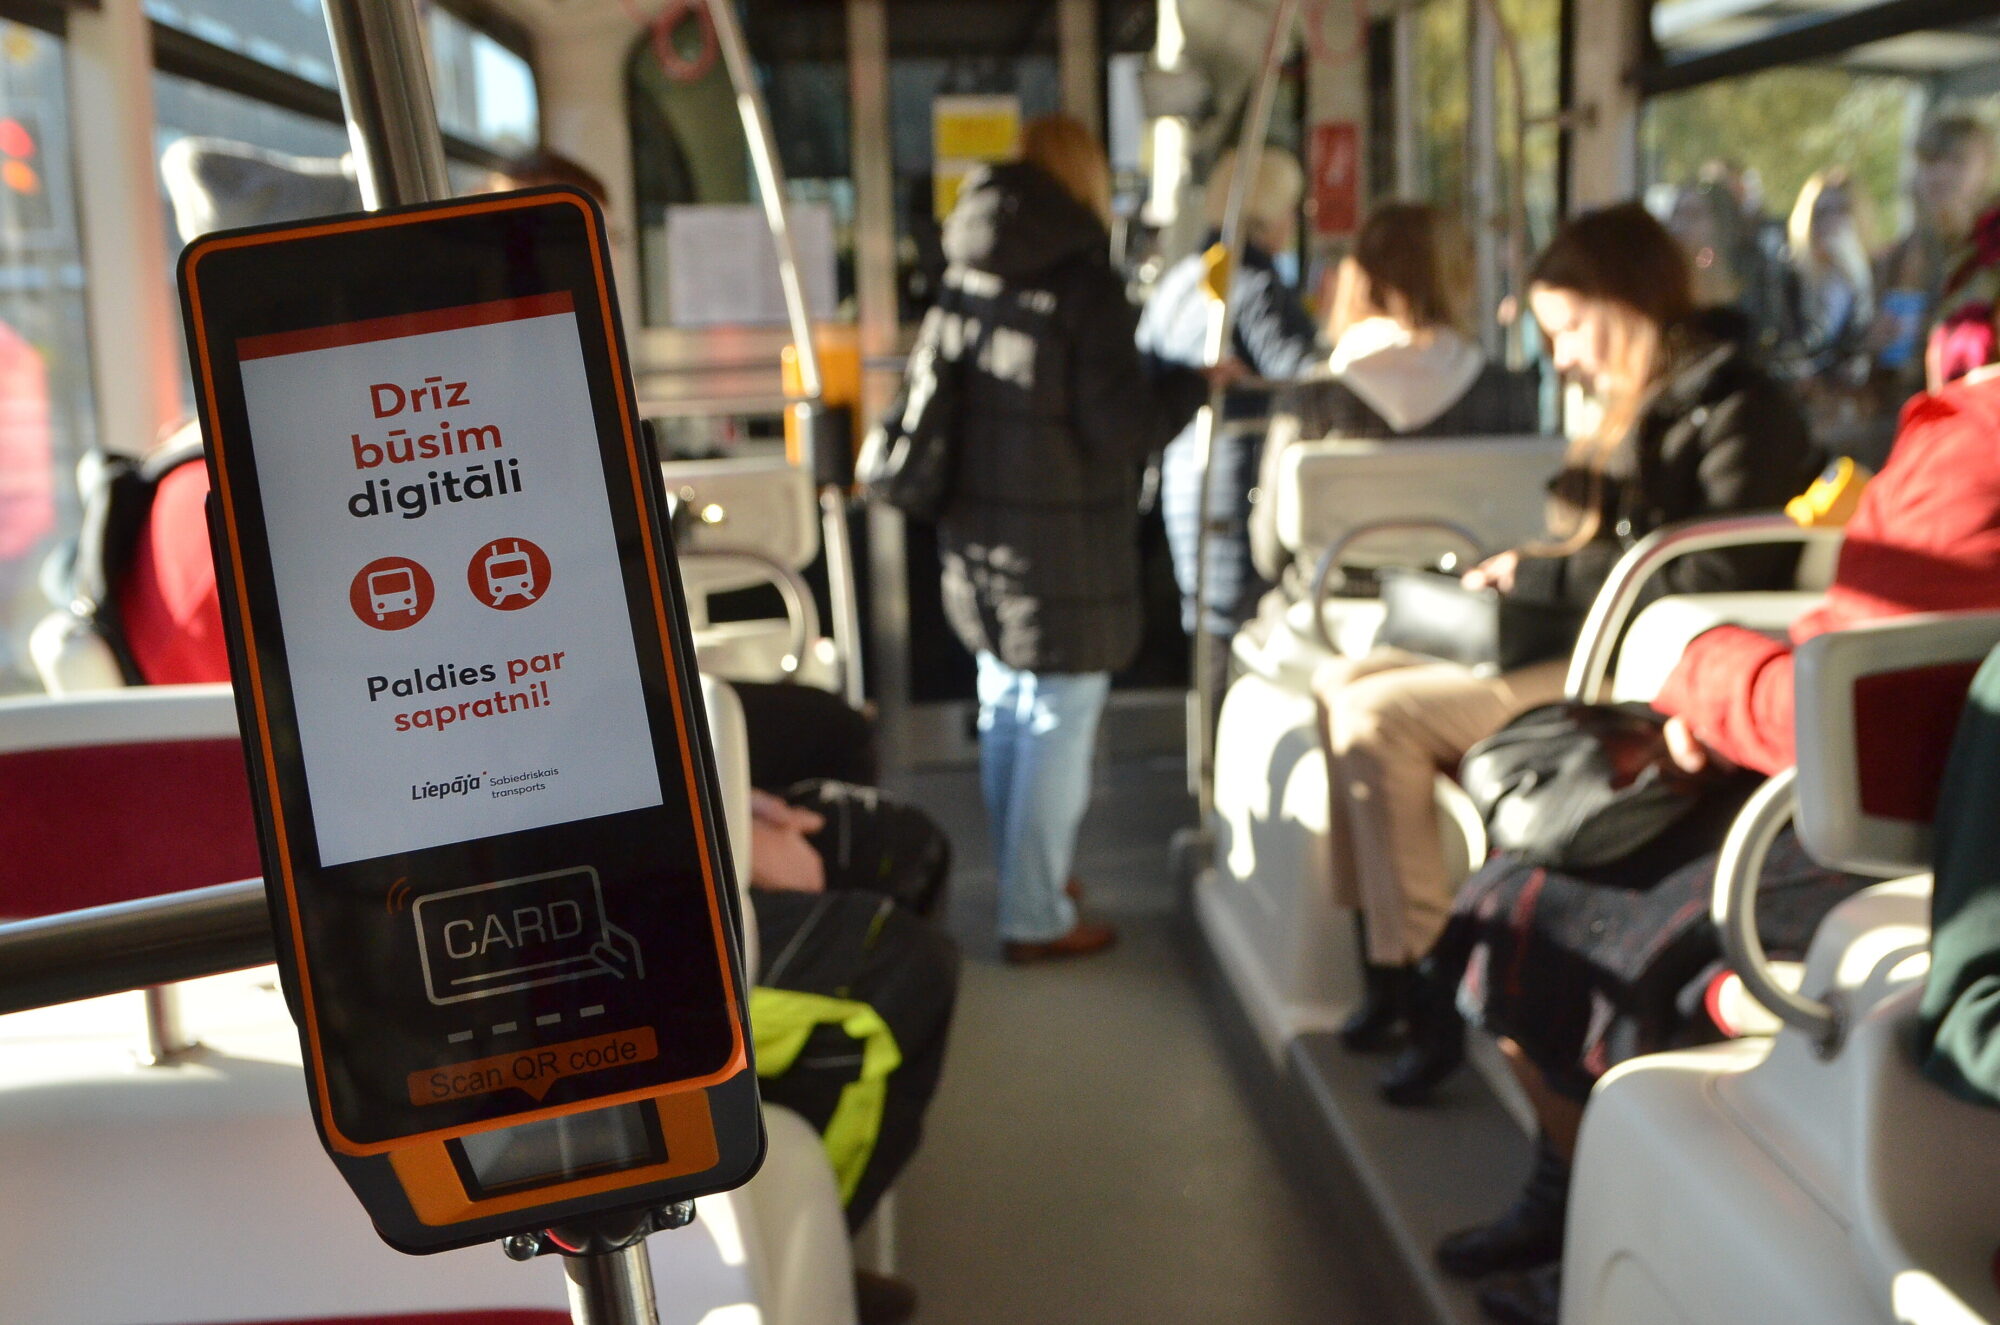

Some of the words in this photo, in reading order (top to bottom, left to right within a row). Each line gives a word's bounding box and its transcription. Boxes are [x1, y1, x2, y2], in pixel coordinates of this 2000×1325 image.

[369, 376, 470, 419] Drīz
[351, 421, 502, 470] būsim
[348, 458, 522, 519] digitāli
[367, 663, 496, 702] Paldies
[507, 651, 565, 684] par
[394, 681, 551, 731] sapratni!
[489, 767, 559, 787] Sabiedriskais
[491, 782, 546, 799] transports
[443, 900, 582, 959] CARD
[430, 1067, 502, 1098] Scan
[512, 1052, 559, 1082] QR
[570, 1038, 637, 1070] code
